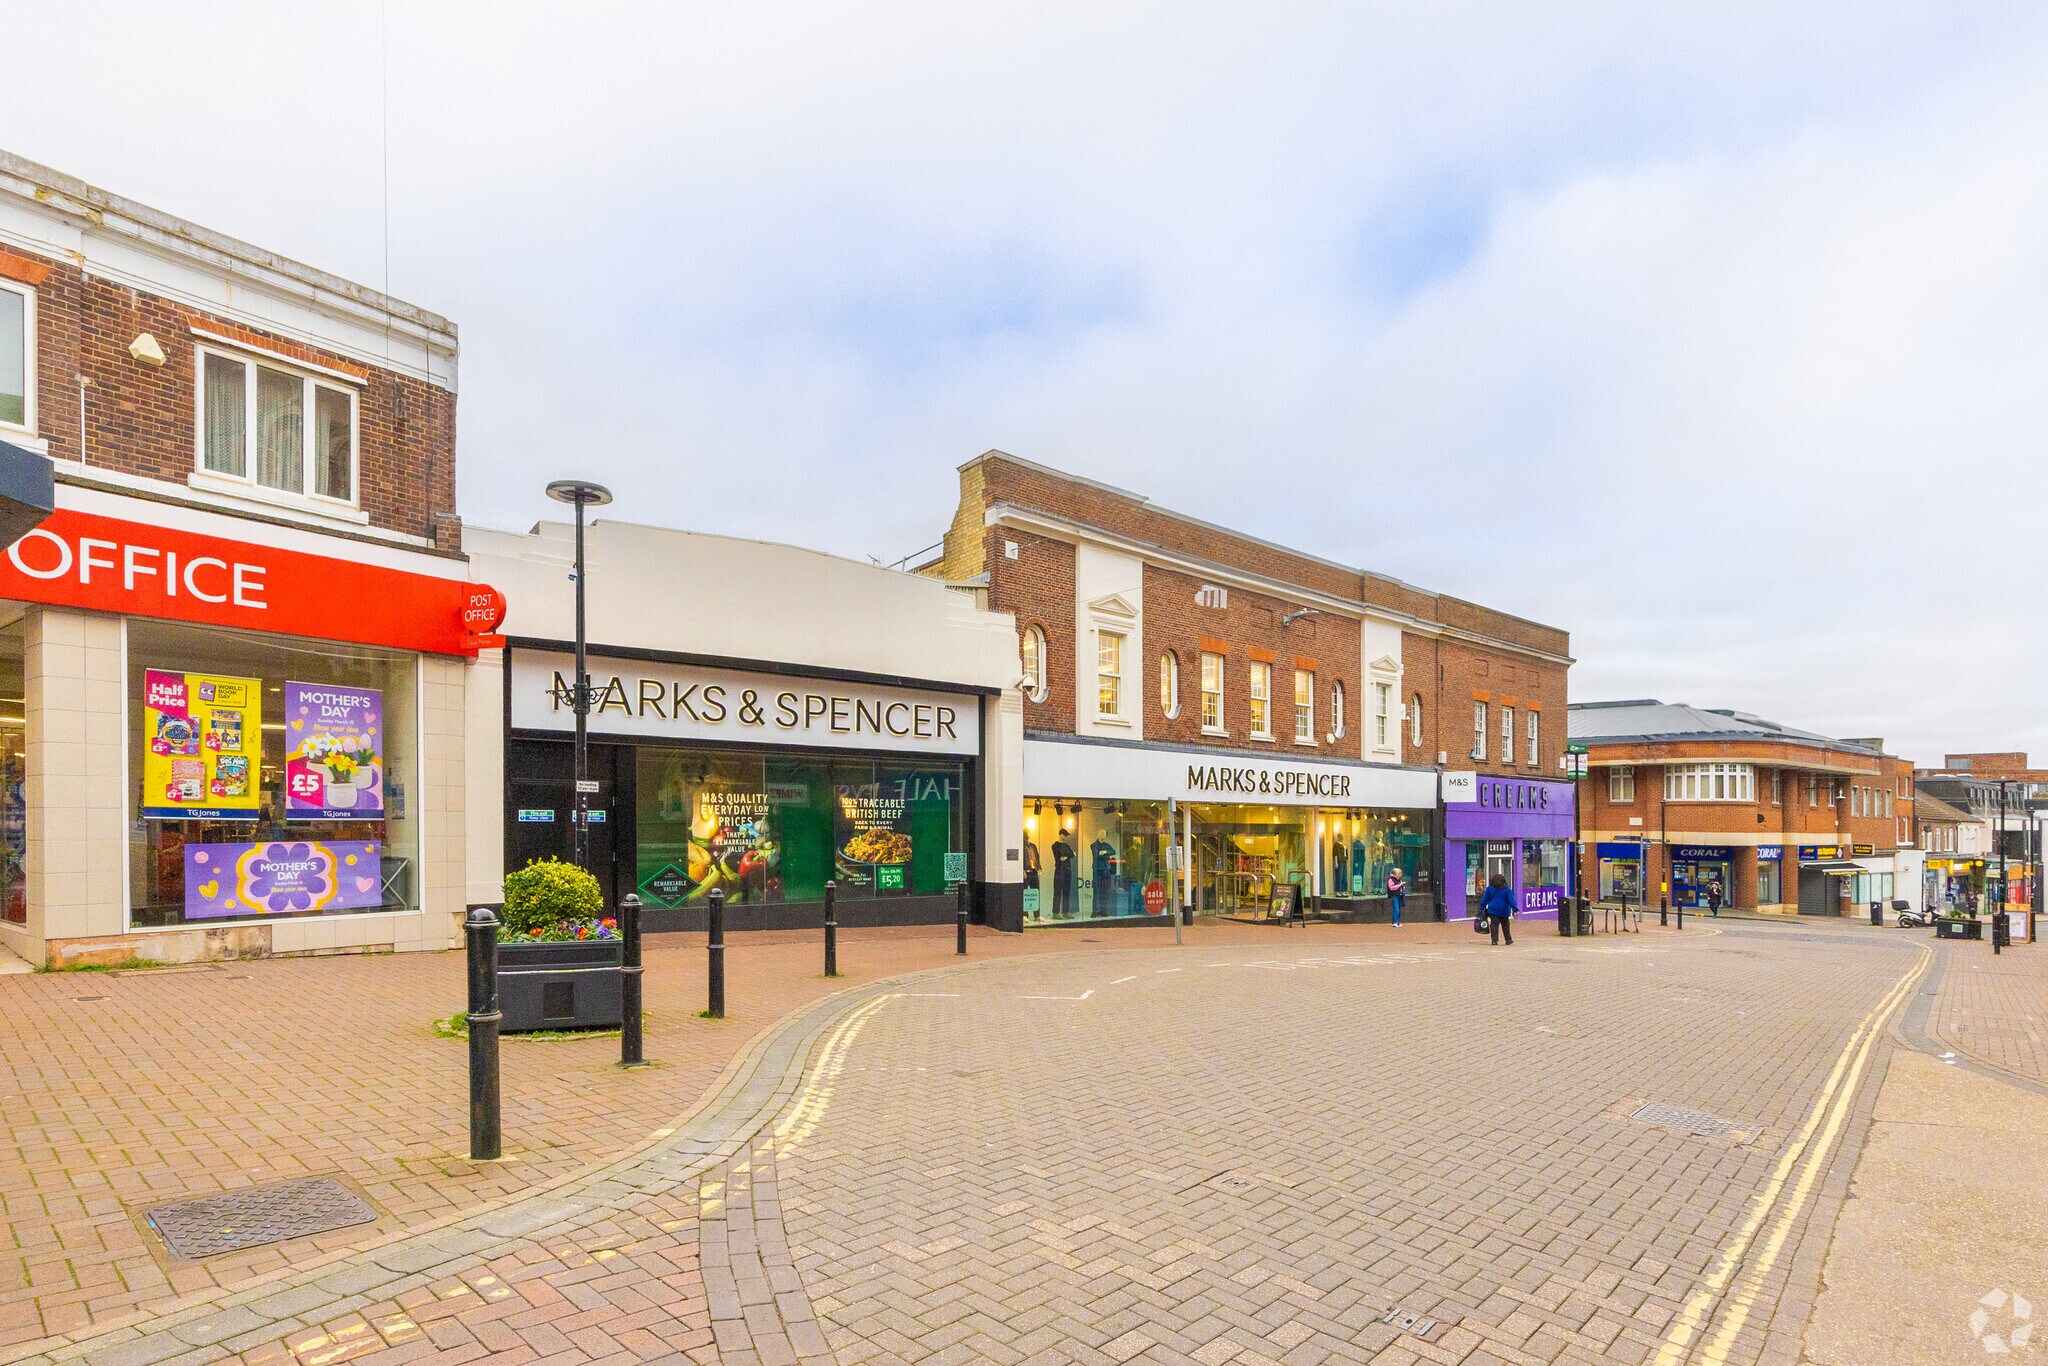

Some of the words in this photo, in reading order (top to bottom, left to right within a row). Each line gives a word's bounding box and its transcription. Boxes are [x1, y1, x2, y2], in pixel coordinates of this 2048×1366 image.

[7, 528, 268, 609] OFFICE
[470, 594, 493, 606] POST
[464, 608, 495, 622] OFFICE
[151, 683, 183, 696] Half
[148, 694, 186, 707] Price
[299, 691, 371, 708] MOTHER'S
[551, 671, 728, 724] MARKS
[738, 688, 766, 726] &
[774, 692, 958, 739] SPENCER
[321, 705, 350, 717] DAY
[292, 774, 319, 792] £5
[1187, 765, 1256, 793] MARKS
[1259, 770, 1271, 793] &
[1273, 771, 1351, 797] SPENCER
[1449, 779, 1469, 787] M&S
[702, 792, 724, 803] M&S
[726, 793, 768, 805] QUALITY
[1481, 782, 1549, 810] CREAMS
[841, 797, 857, 805] 100%
[859, 798, 906, 809] TRACEABLE
[701, 804, 752, 815] EVERYDAY
[845, 809, 879, 819] BRITISH
[881, 809, 903, 819] BEEF
[718, 816, 753, 827] PRICES
[1489, 844, 1510, 852] CREAMS
[1680, 848, 1720, 857] CORAL
[260, 862, 317, 872] MOTHER'S
[277, 871, 300, 880] DAY
[882, 875, 900, 887] £5.20
[1147, 890, 1164, 898] sale
[1525, 890, 1558, 908] CREAMS
